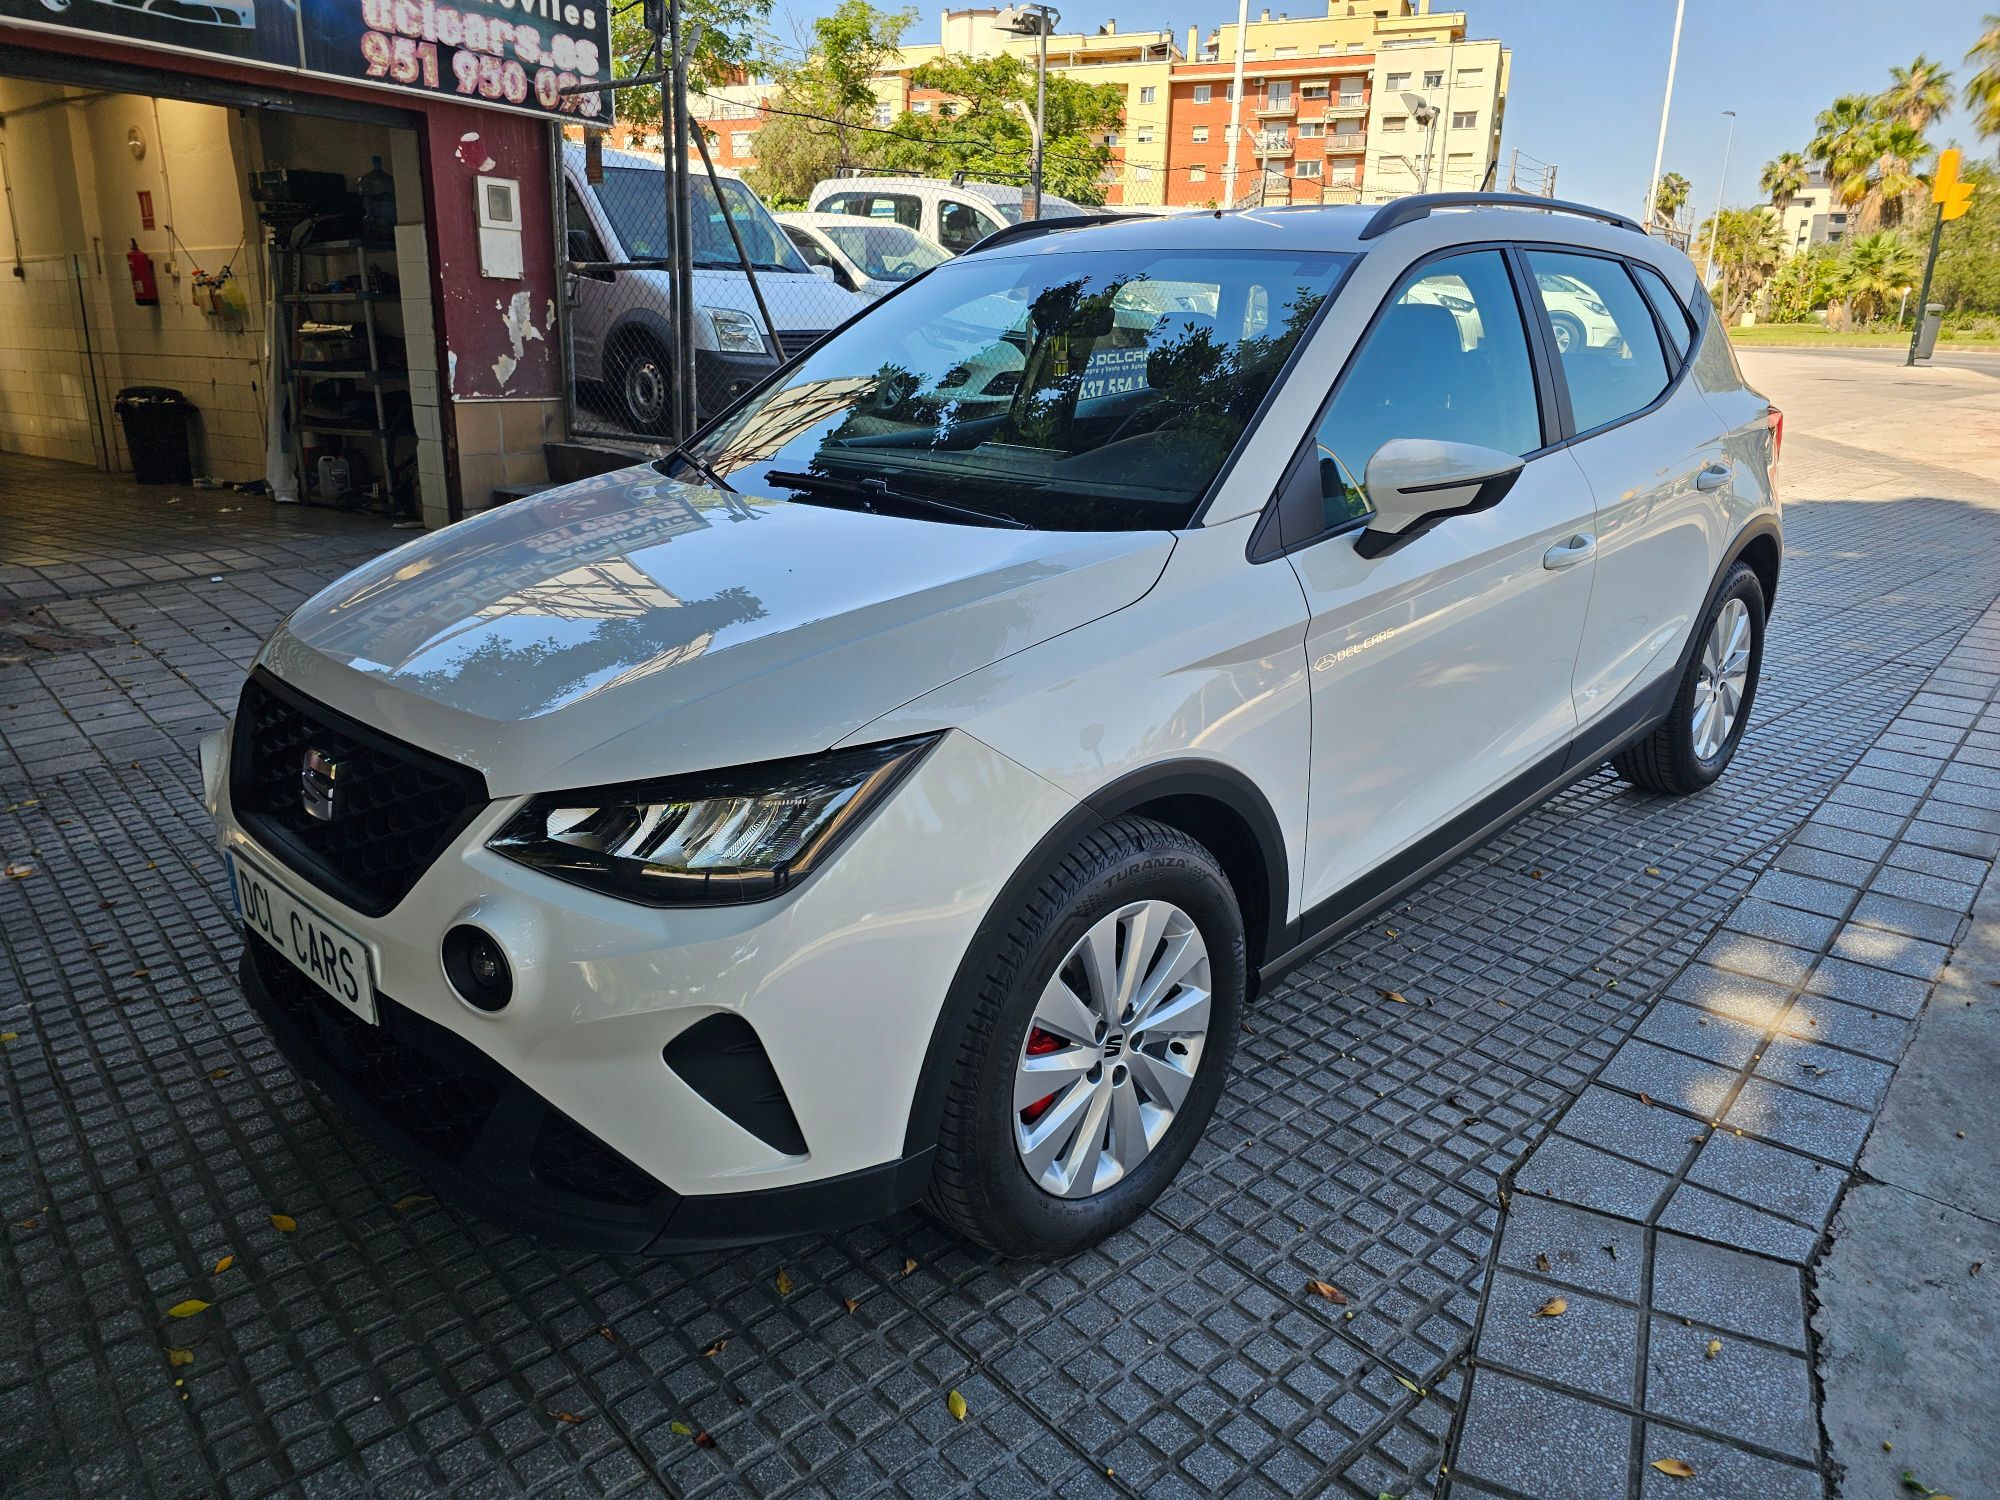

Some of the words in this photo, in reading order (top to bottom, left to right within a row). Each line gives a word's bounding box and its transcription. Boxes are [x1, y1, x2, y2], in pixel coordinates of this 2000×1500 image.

[360, 31, 440, 88] 951
[452, 50, 528, 104] 950
[1108, 376, 1133, 395] 554
[1103, 857, 1187, 889] TURANZA
[239, 868, 285, 948] DCL
[290, 910, 359, 1003] CARS
